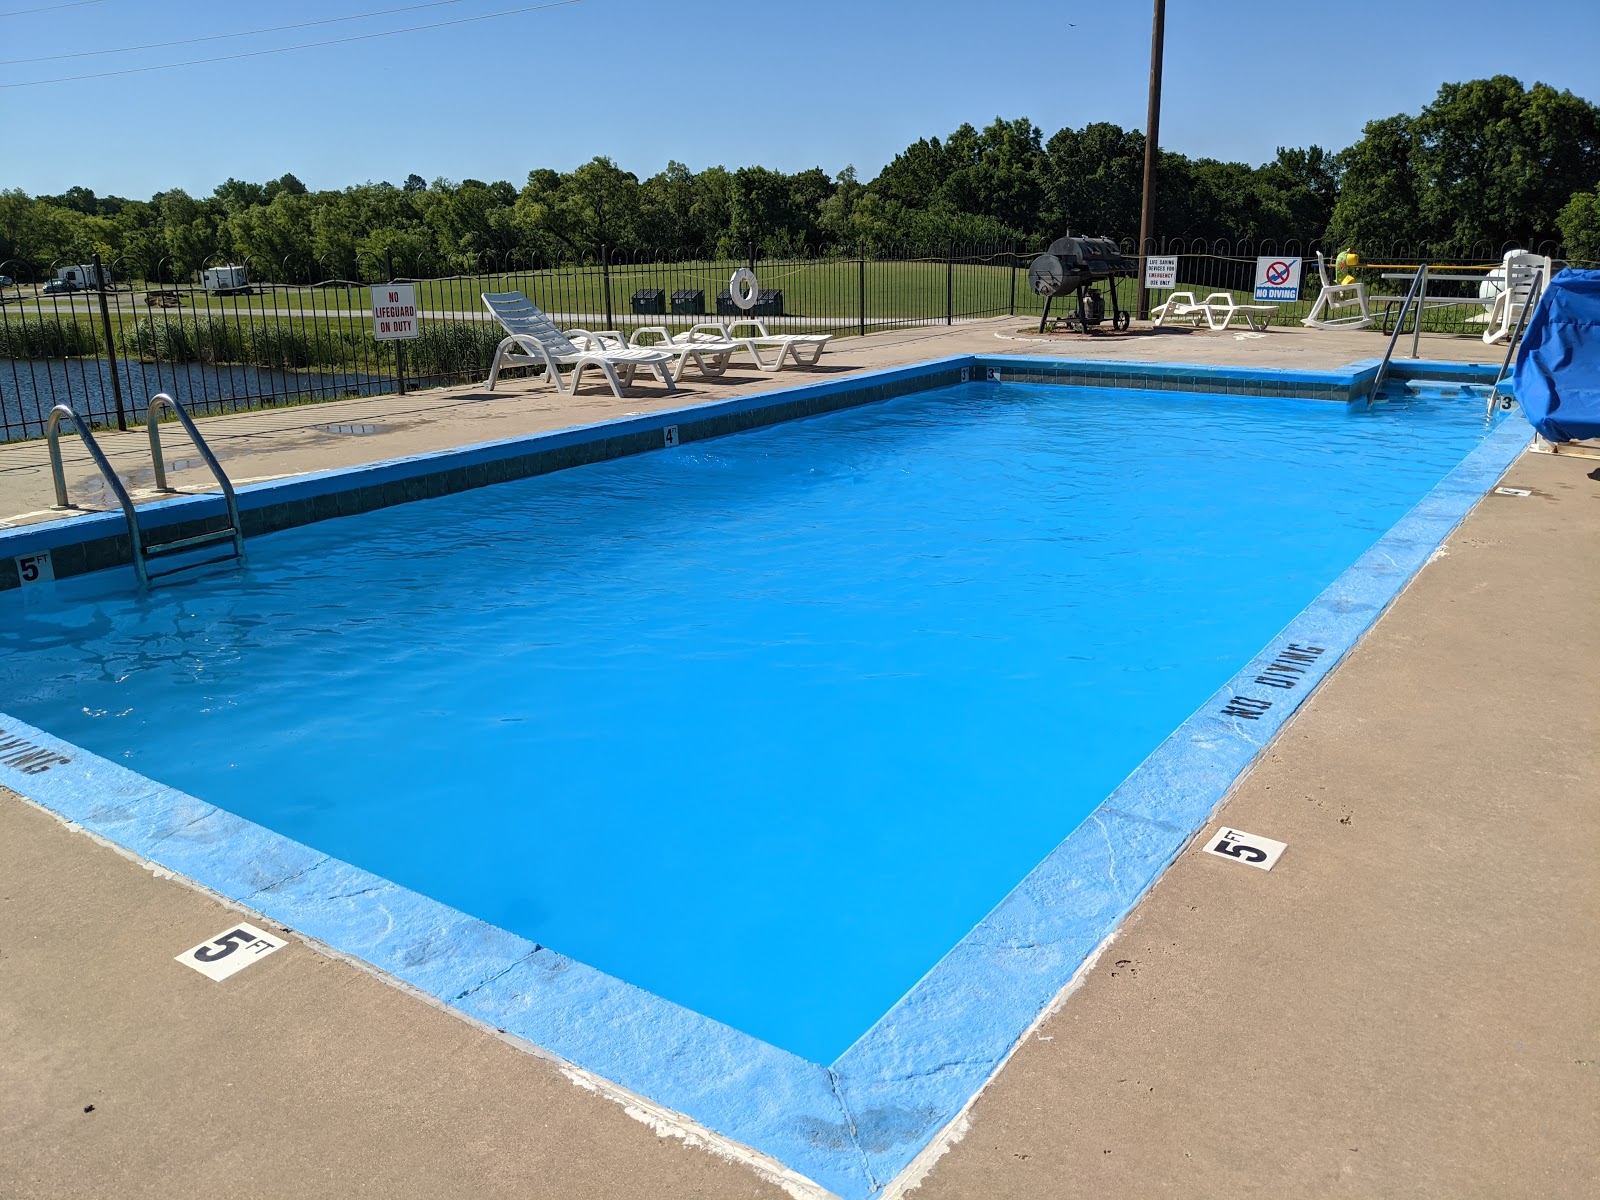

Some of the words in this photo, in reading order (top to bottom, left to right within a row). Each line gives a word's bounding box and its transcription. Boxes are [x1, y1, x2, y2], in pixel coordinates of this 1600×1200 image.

[388, 292, 399, 303] NO
[1256, 289, 1268, 298] NO
[1269, 289, 1296, 299] DIVING
[376, 306, 414, 318] LIFEGUARD
[380, 322, 391, 333] ON
[393, 321, 411, 332] DUTY
[988, 368, 995, 379] 3
[1502, 396, 1512, 410] 3
[666, 428, 673, 444] 4
[20, 557, 39, 582] 5
[36, 554, 48, 564] FT
[1221, 696, 1273, 720] NO
[1254, 643, 1325, 690] DIVING
[0, 729, 71, 775] VING
[1224, 829, 1245, 843] FT
[1213, 839, 1267, 863] 5
[193, 929, 257, 963] 5
[244, 939, 276, 955] FT
